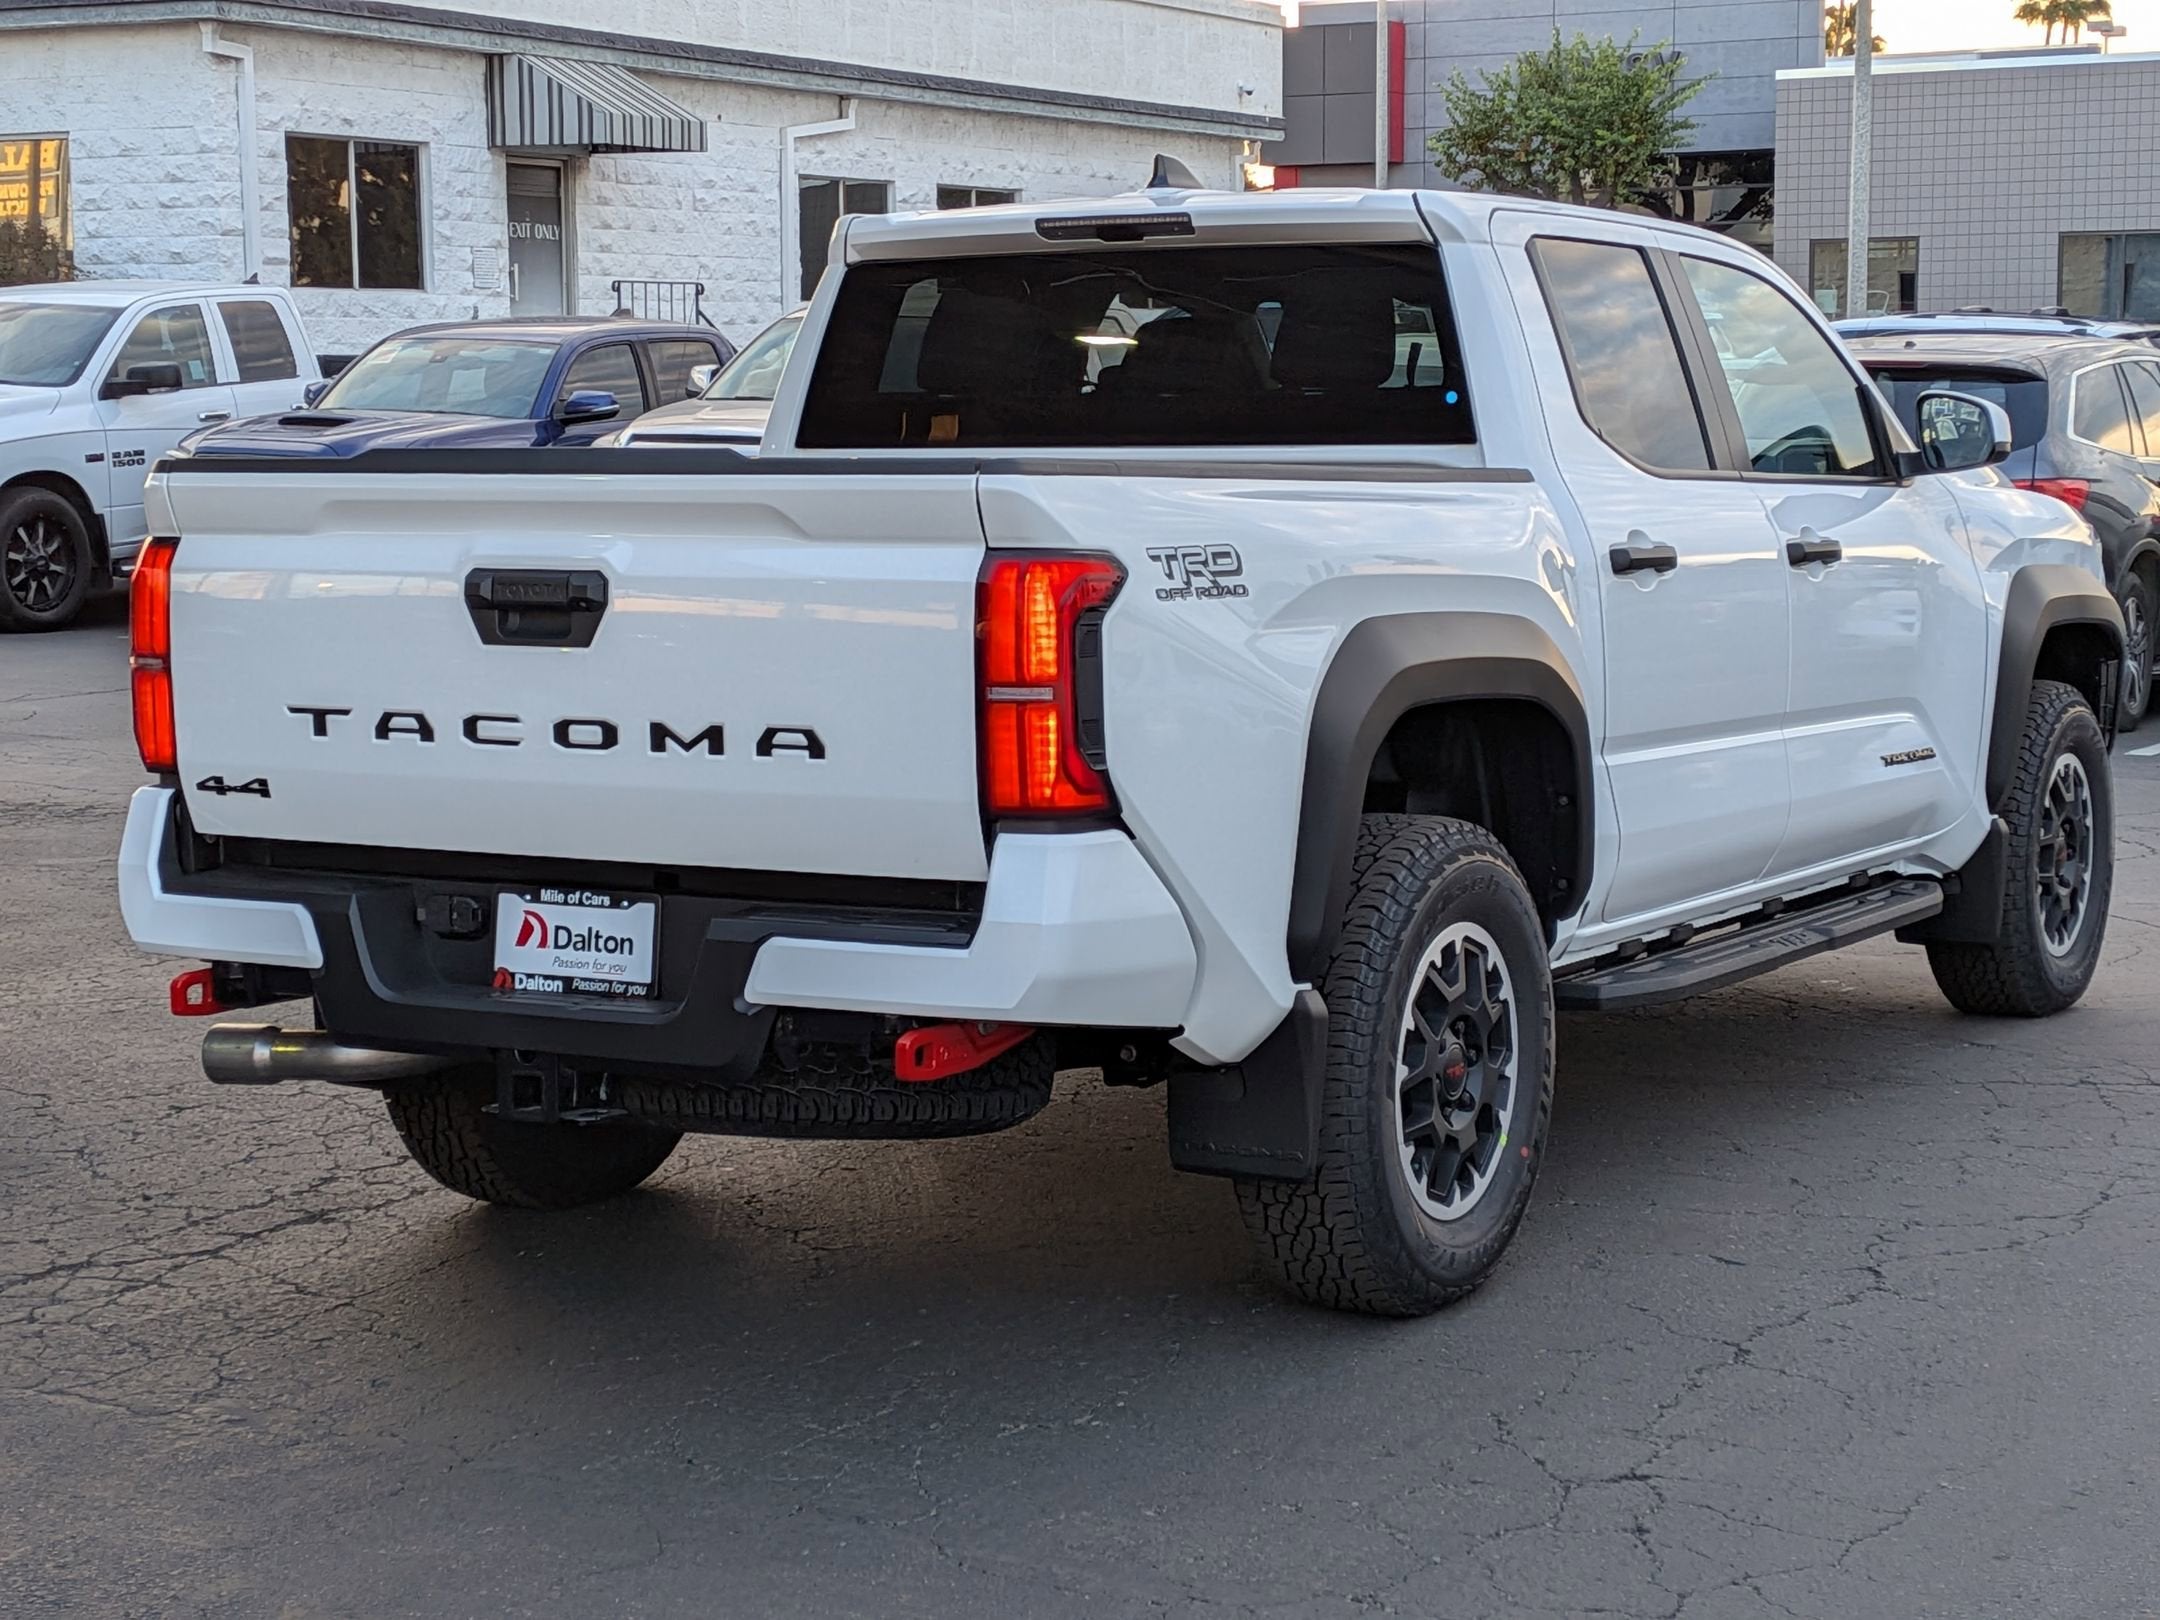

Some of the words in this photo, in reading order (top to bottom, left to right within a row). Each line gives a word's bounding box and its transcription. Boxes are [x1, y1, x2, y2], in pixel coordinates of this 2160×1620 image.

[509, 222, 532, 239] EXIT
[534, 223, 561, 241] ONLY
[112, 450, 145, 459] RAM
[112, 458, 146, 468] 1500
[1146, 543, 1244, 588] TRD
[1155, 587, 1193, 601] OFF
[1194, 584, 1249, 600] ROAD
[286, 705, 827, 761] TACOMA
[540, 889, 564, 904] Mile
[567, 893, 581, 905] of
[582, 892, 611, 906] Cars
[553, 925, 634, 956] Dalton
[552, 956, 590, 971] Passion
[592, 958, 607, 971] for
[608, 962, 628, 973] you
[514, 973, 564, 993] Dalton
[571, 978, 610, 993] Passion
[611, 981, 626, 994] for
[626, 983, 648, 996] you
